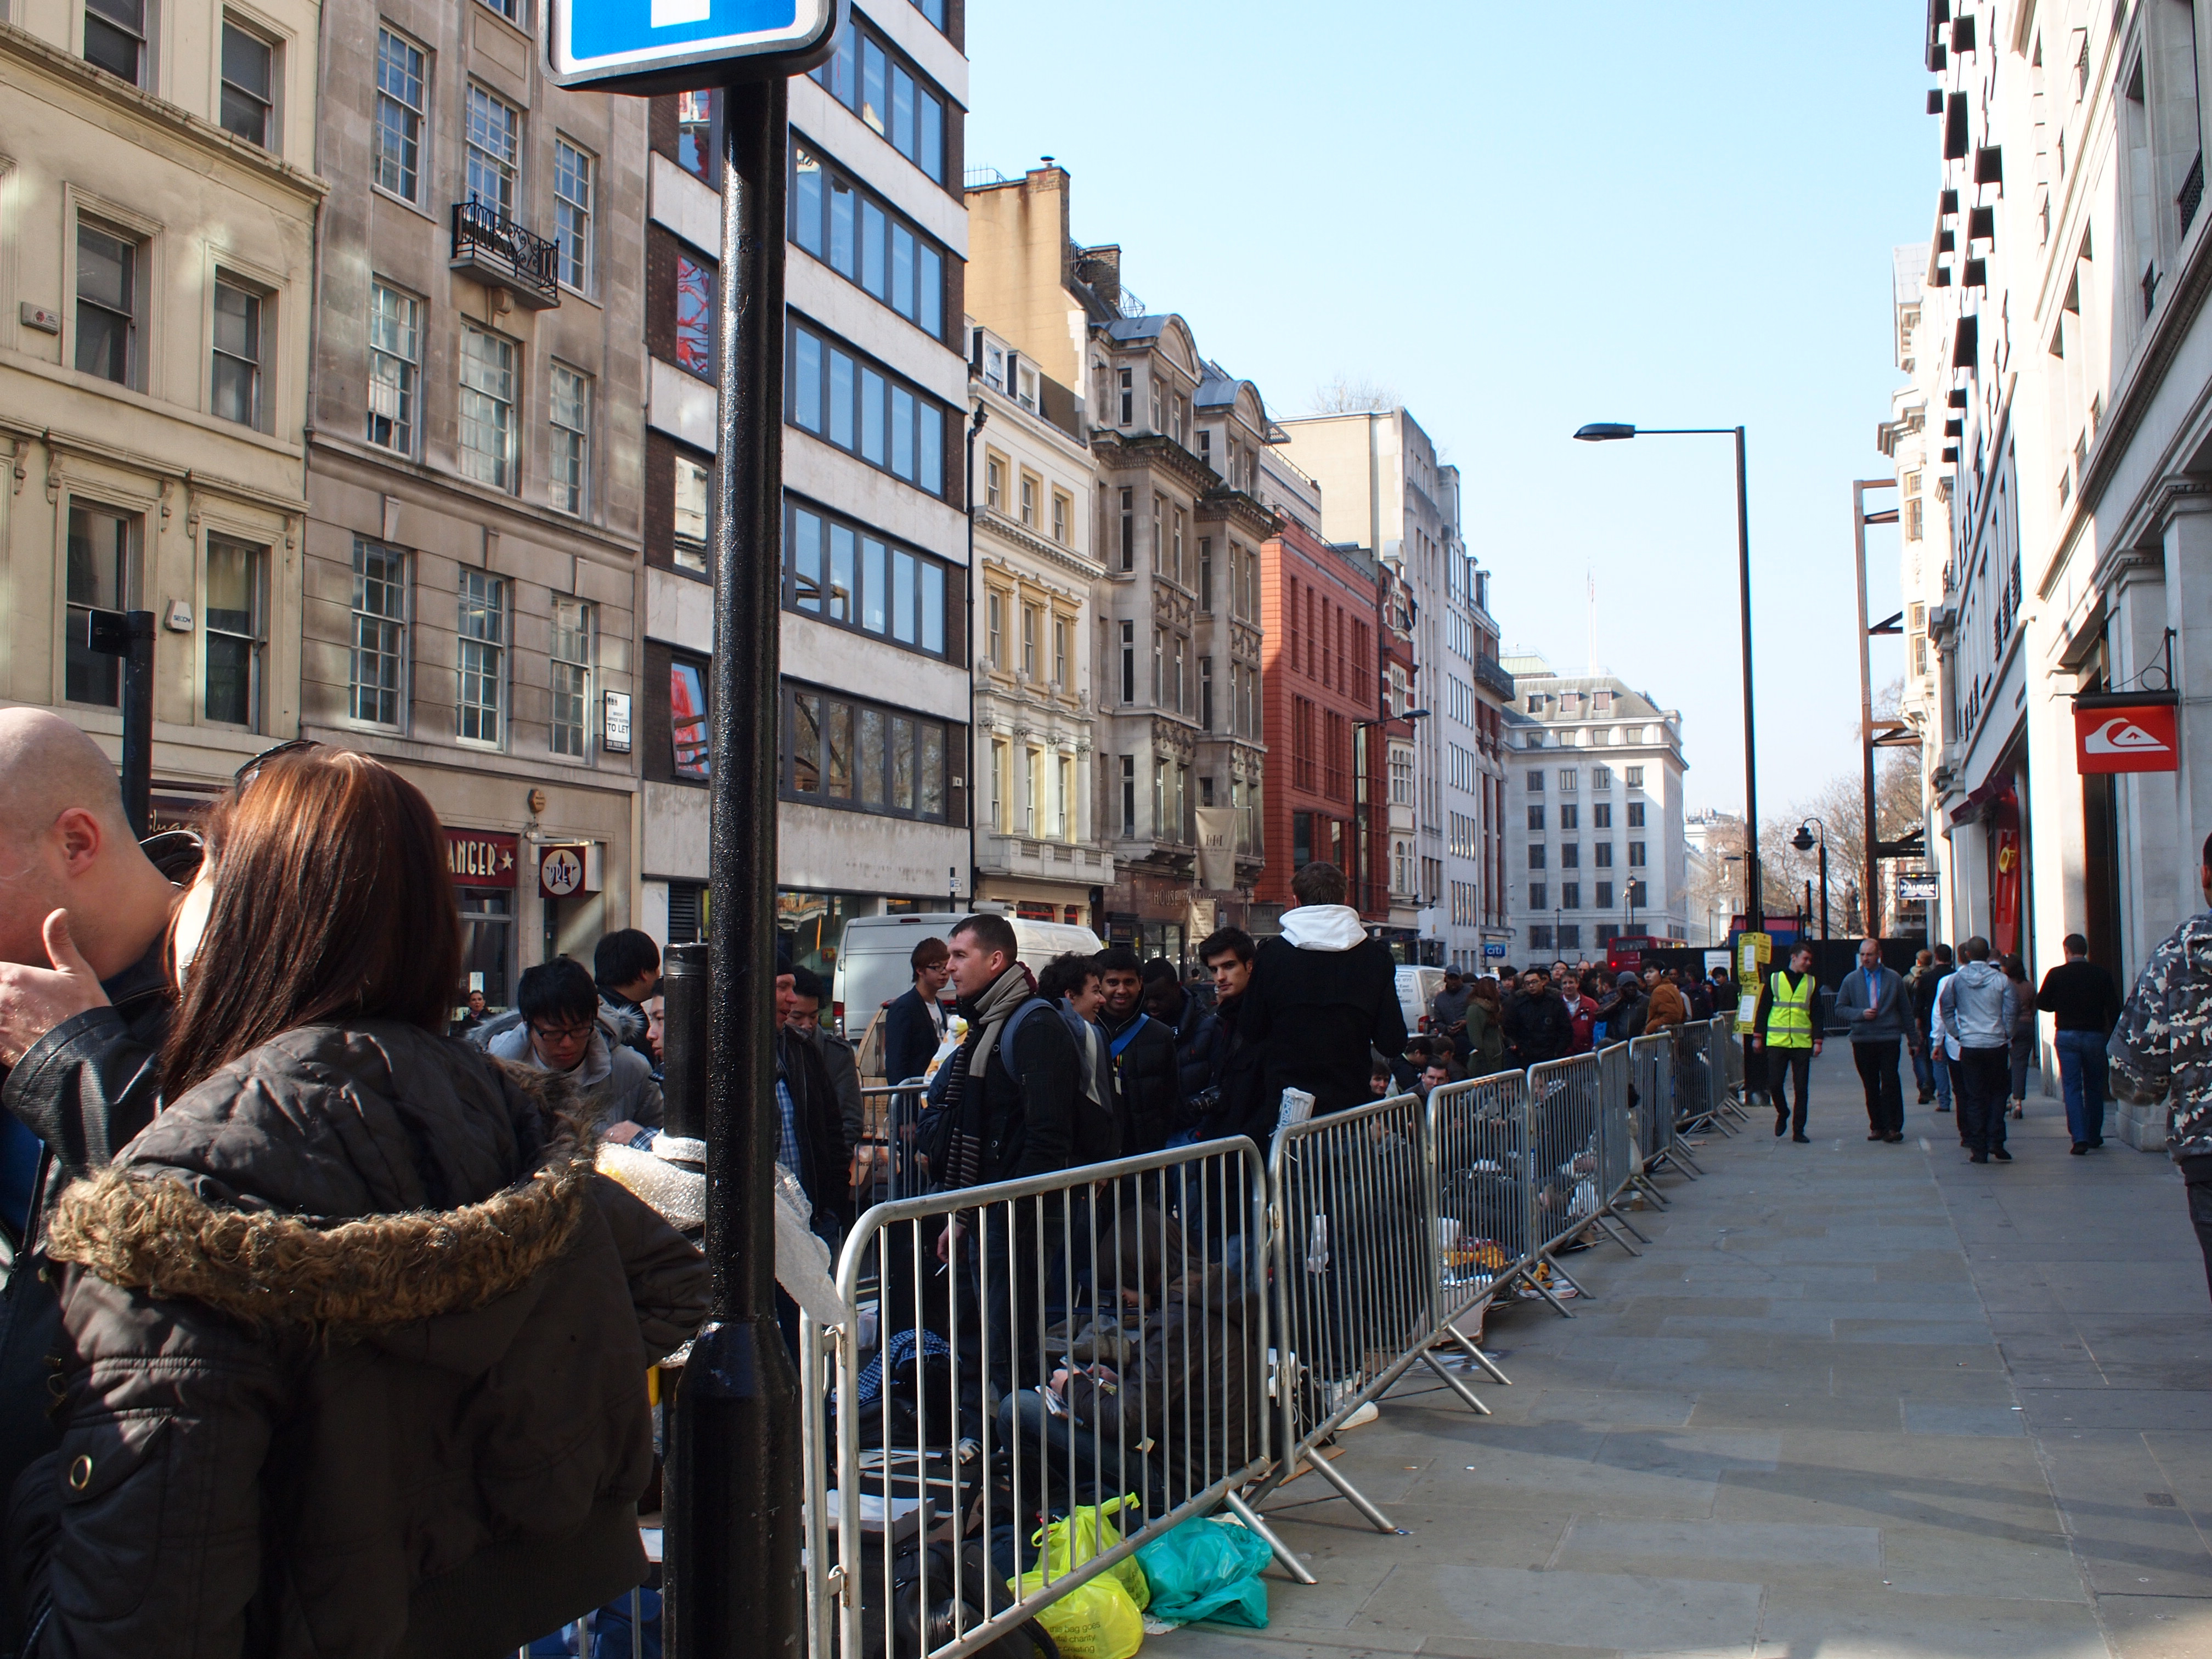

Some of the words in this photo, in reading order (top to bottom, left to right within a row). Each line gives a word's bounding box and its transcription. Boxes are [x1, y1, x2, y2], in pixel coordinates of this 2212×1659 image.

[607, 723, 616, 732] TO
[618, 725, 629, 734] LET
[448, 839, 496, 876] ANGER
[549, 863, 574, 883] PRET
[1153, 889, 1178, 906] HOUSE
[1487, 946, 1502, 955] citi
[1064, 1625, 1080, 1634] bag
[1082, 1622, 1101, 1633] goes
[1069, 1634, 1096, 1643] charity
